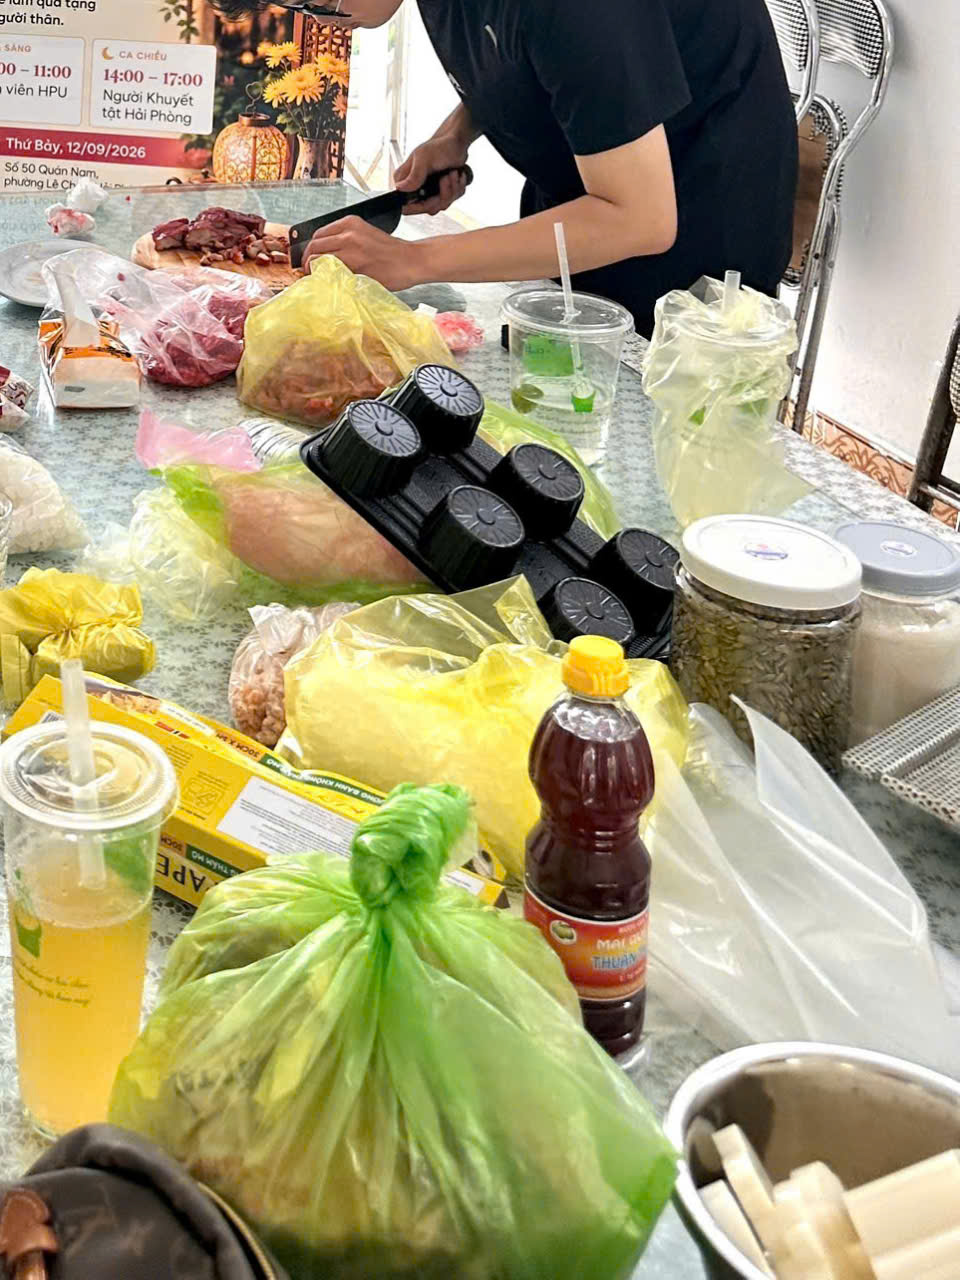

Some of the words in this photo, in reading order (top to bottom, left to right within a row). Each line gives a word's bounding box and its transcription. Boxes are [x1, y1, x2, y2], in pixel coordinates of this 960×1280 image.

[30, 13, 64, 26] thân.
[119, 51, 133, 59] CA
[34, 64, 72, 79] 11:00
[104, 68, 144, 84] 14:00
[163, 72, 203, 87] 17:00
[6, 83, 34, 96] viên
[38, 85, 67, 98] HPU
[103, 89, 143, 104] Người
[147, 92, 194, 108] Khuyết
[102, 106, 121, 121] tật
[125, 108, 146, 120] Hải
[150, 109, 192, 126] Phòng
[6, 137, 32, 150] Thứ
[34, 138, 63, 154] Bảy,
[66, 141, 146, 158] 12/09/2026
[5, 161, 19, 172] Số
[22, 163, 36, 174] 50
[38, 163, 68, 176] Quán
[70, 167, 99, 179] Nam,
[4, 176, 44, 190] phường
[46, 178, 59, 188] Lê
